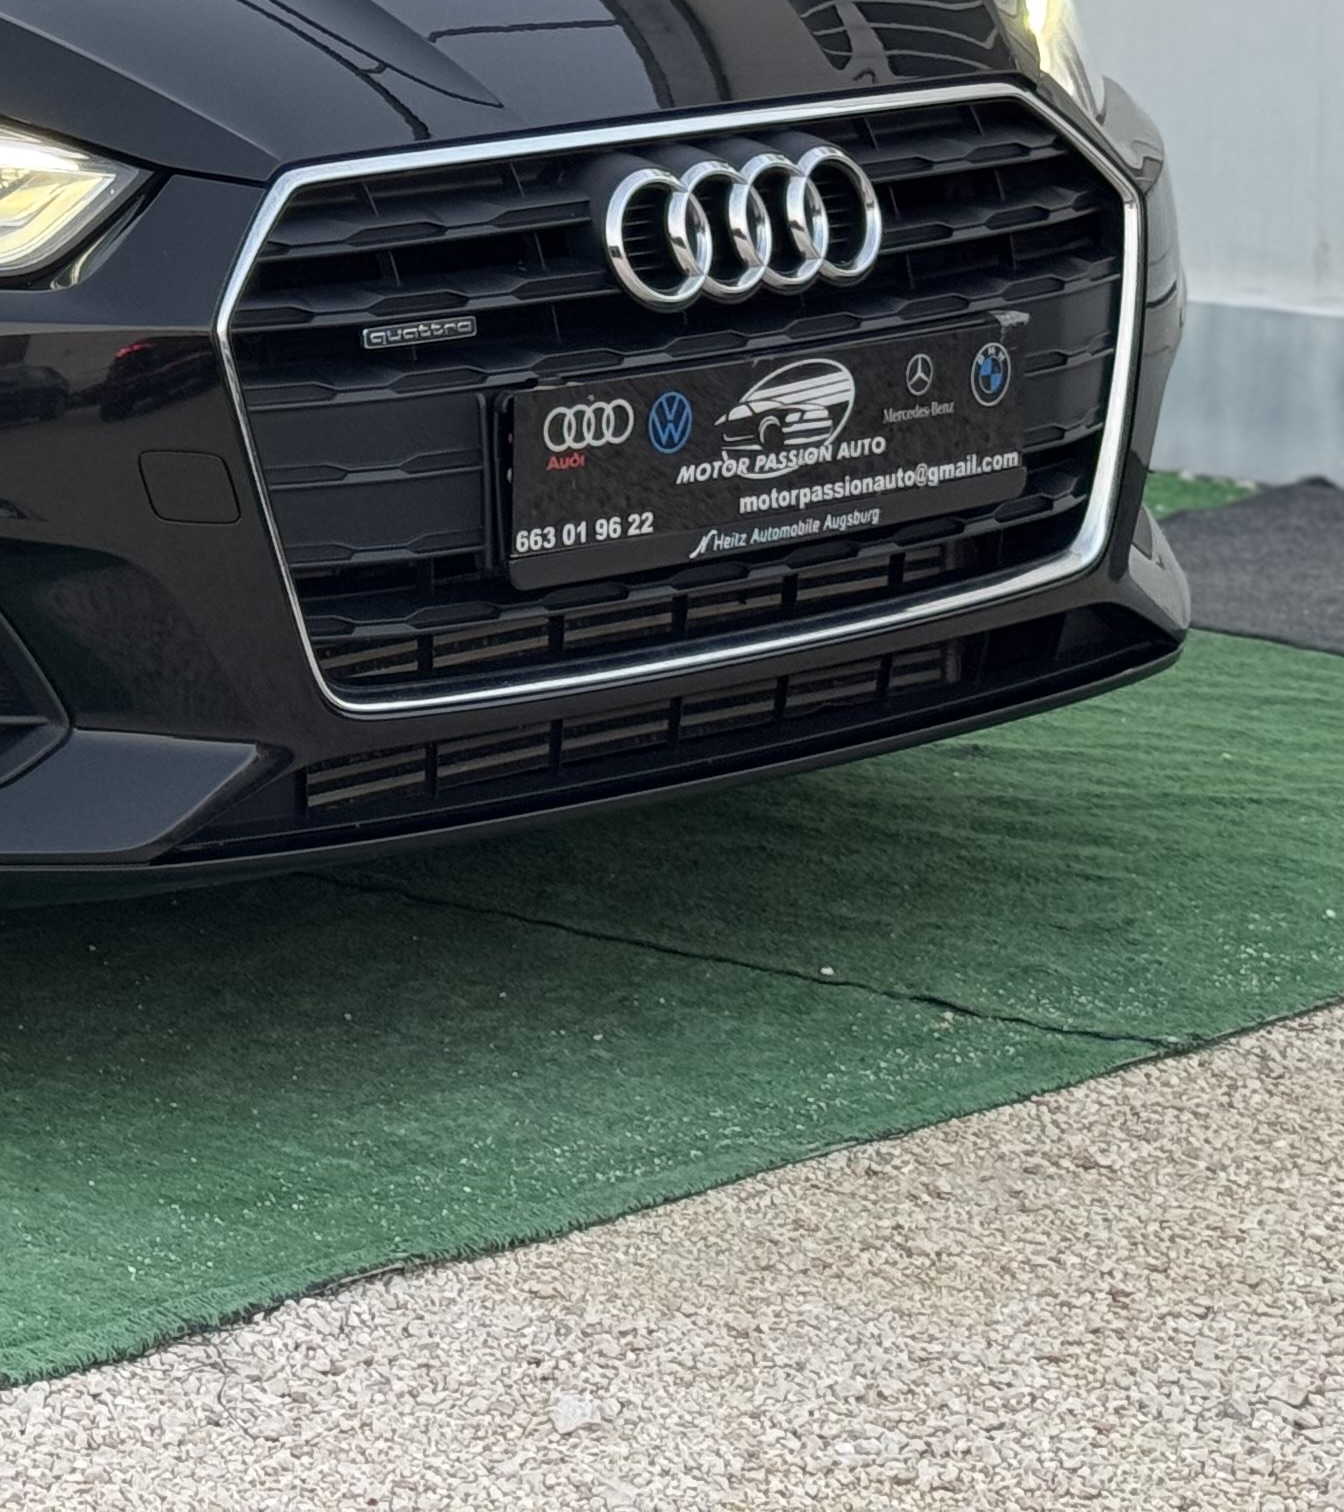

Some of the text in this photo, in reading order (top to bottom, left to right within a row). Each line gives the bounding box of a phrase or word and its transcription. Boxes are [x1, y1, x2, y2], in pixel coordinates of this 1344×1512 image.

[370, 320, 472, 345] quattro
[545, 452, 586, 471] Audi
[675, 435, 887, 485] MOTOR PASSION AUTO
[738, 450, 1020, 515] motorpassionauto@gmail.com
[515, 511, 655, 553] 663 01 96 22
[713, 508, 881, 552] Heitz Automobile Augsburg
